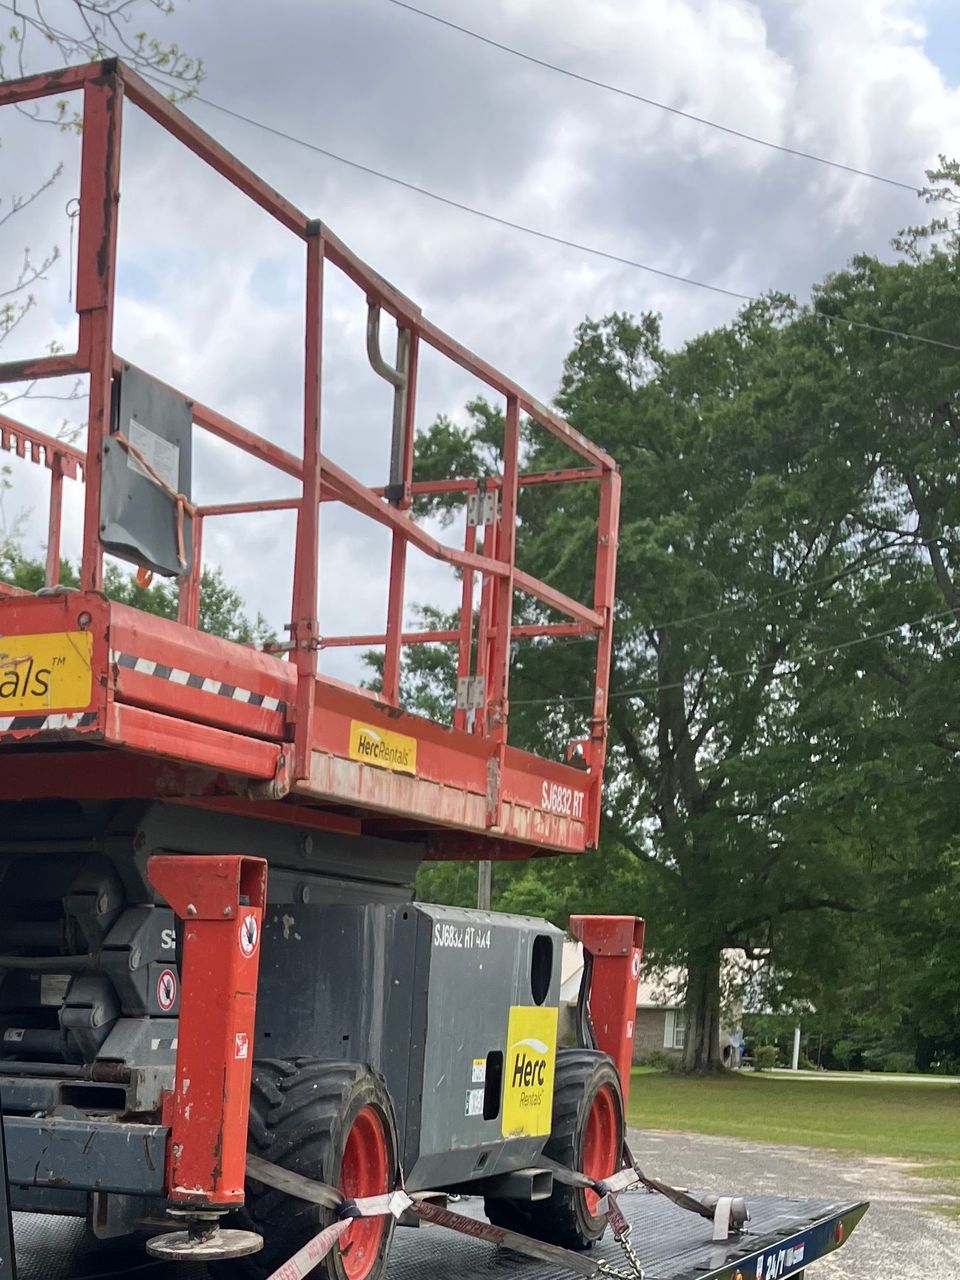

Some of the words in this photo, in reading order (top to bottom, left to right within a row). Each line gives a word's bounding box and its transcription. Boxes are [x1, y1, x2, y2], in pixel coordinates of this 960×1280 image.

[542, 780, 572, 815] SJ6832
[572, 790, 585, 818] RT
[512, 1053, 546, 1088] Herc
